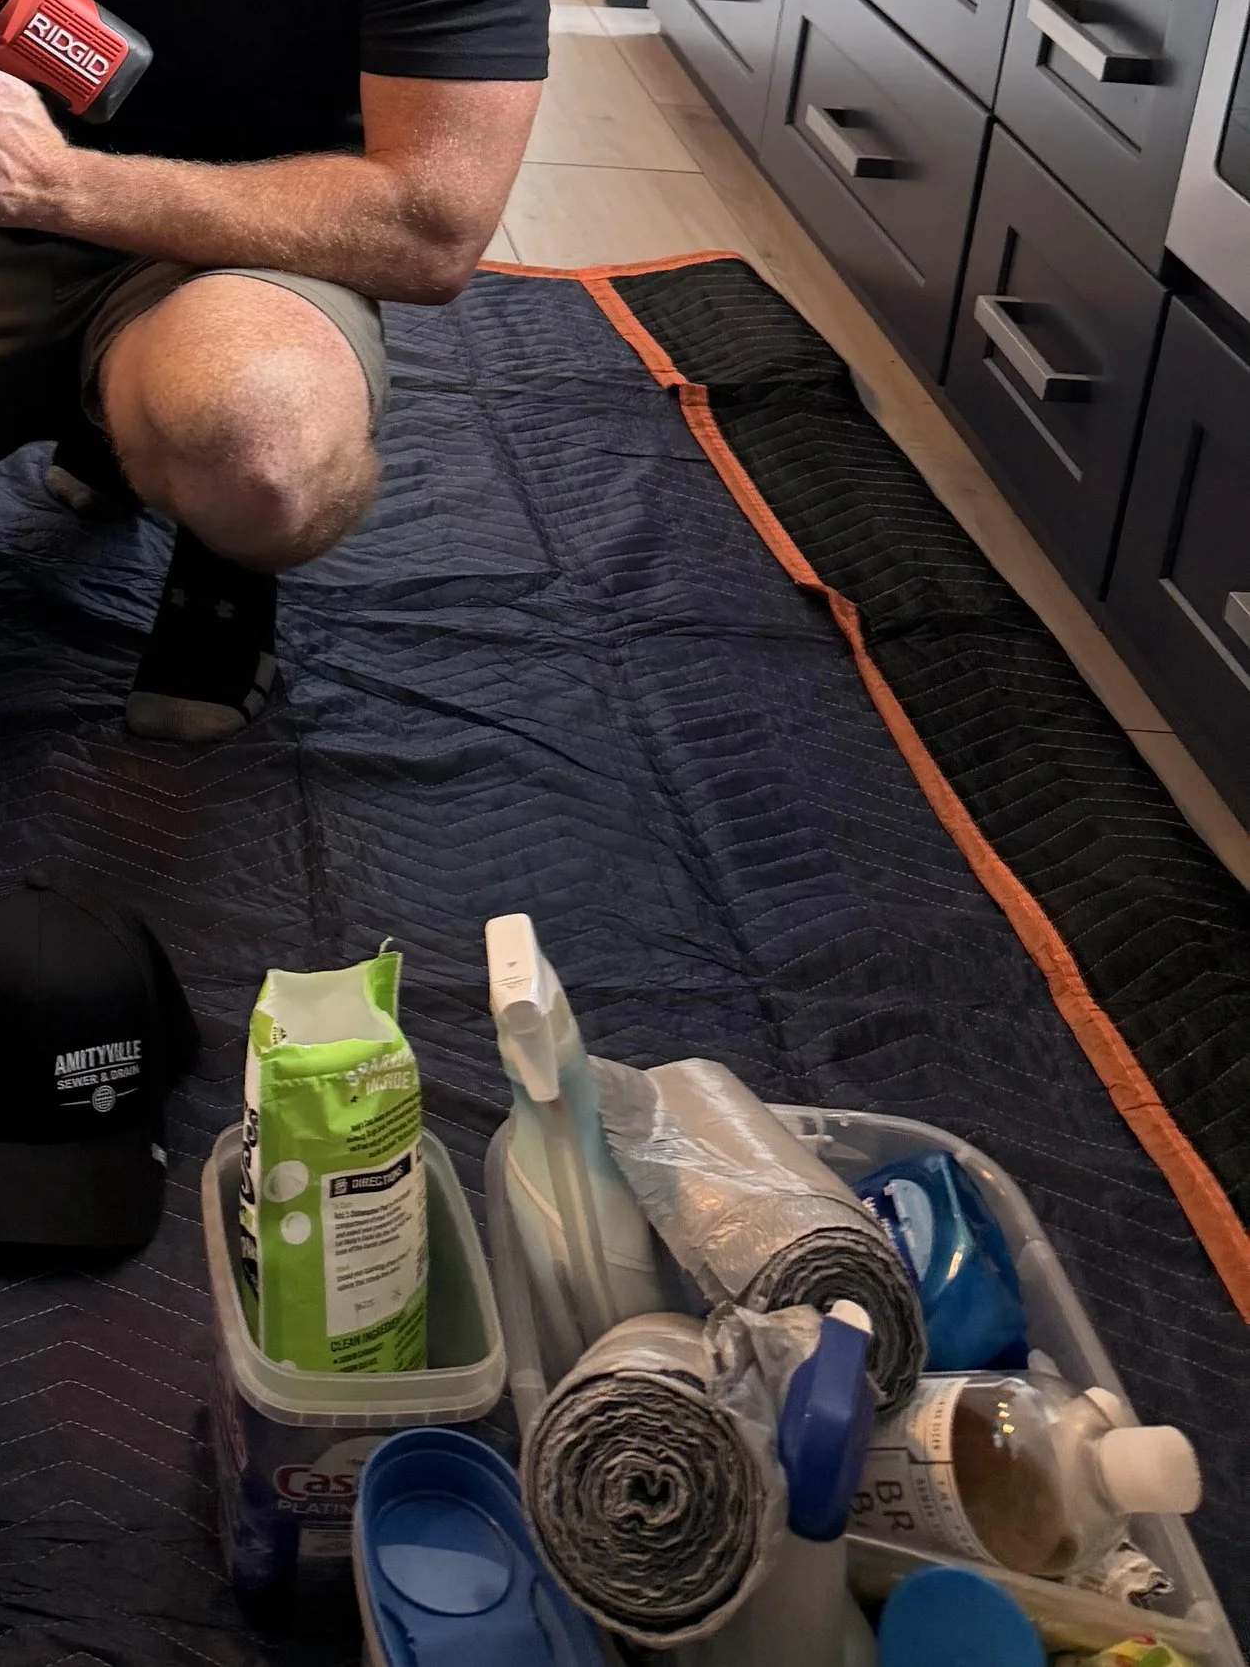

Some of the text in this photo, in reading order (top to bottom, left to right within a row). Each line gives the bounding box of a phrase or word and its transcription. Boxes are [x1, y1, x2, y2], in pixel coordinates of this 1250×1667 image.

[27, 13, 110, 77] RIDGID
[54, 1040, 142, 1076] AMITYVILLE
[57, 1064, 140, 1090] SEWER & DRAIN
[330, 1336, 361, 1352] CLEAN
